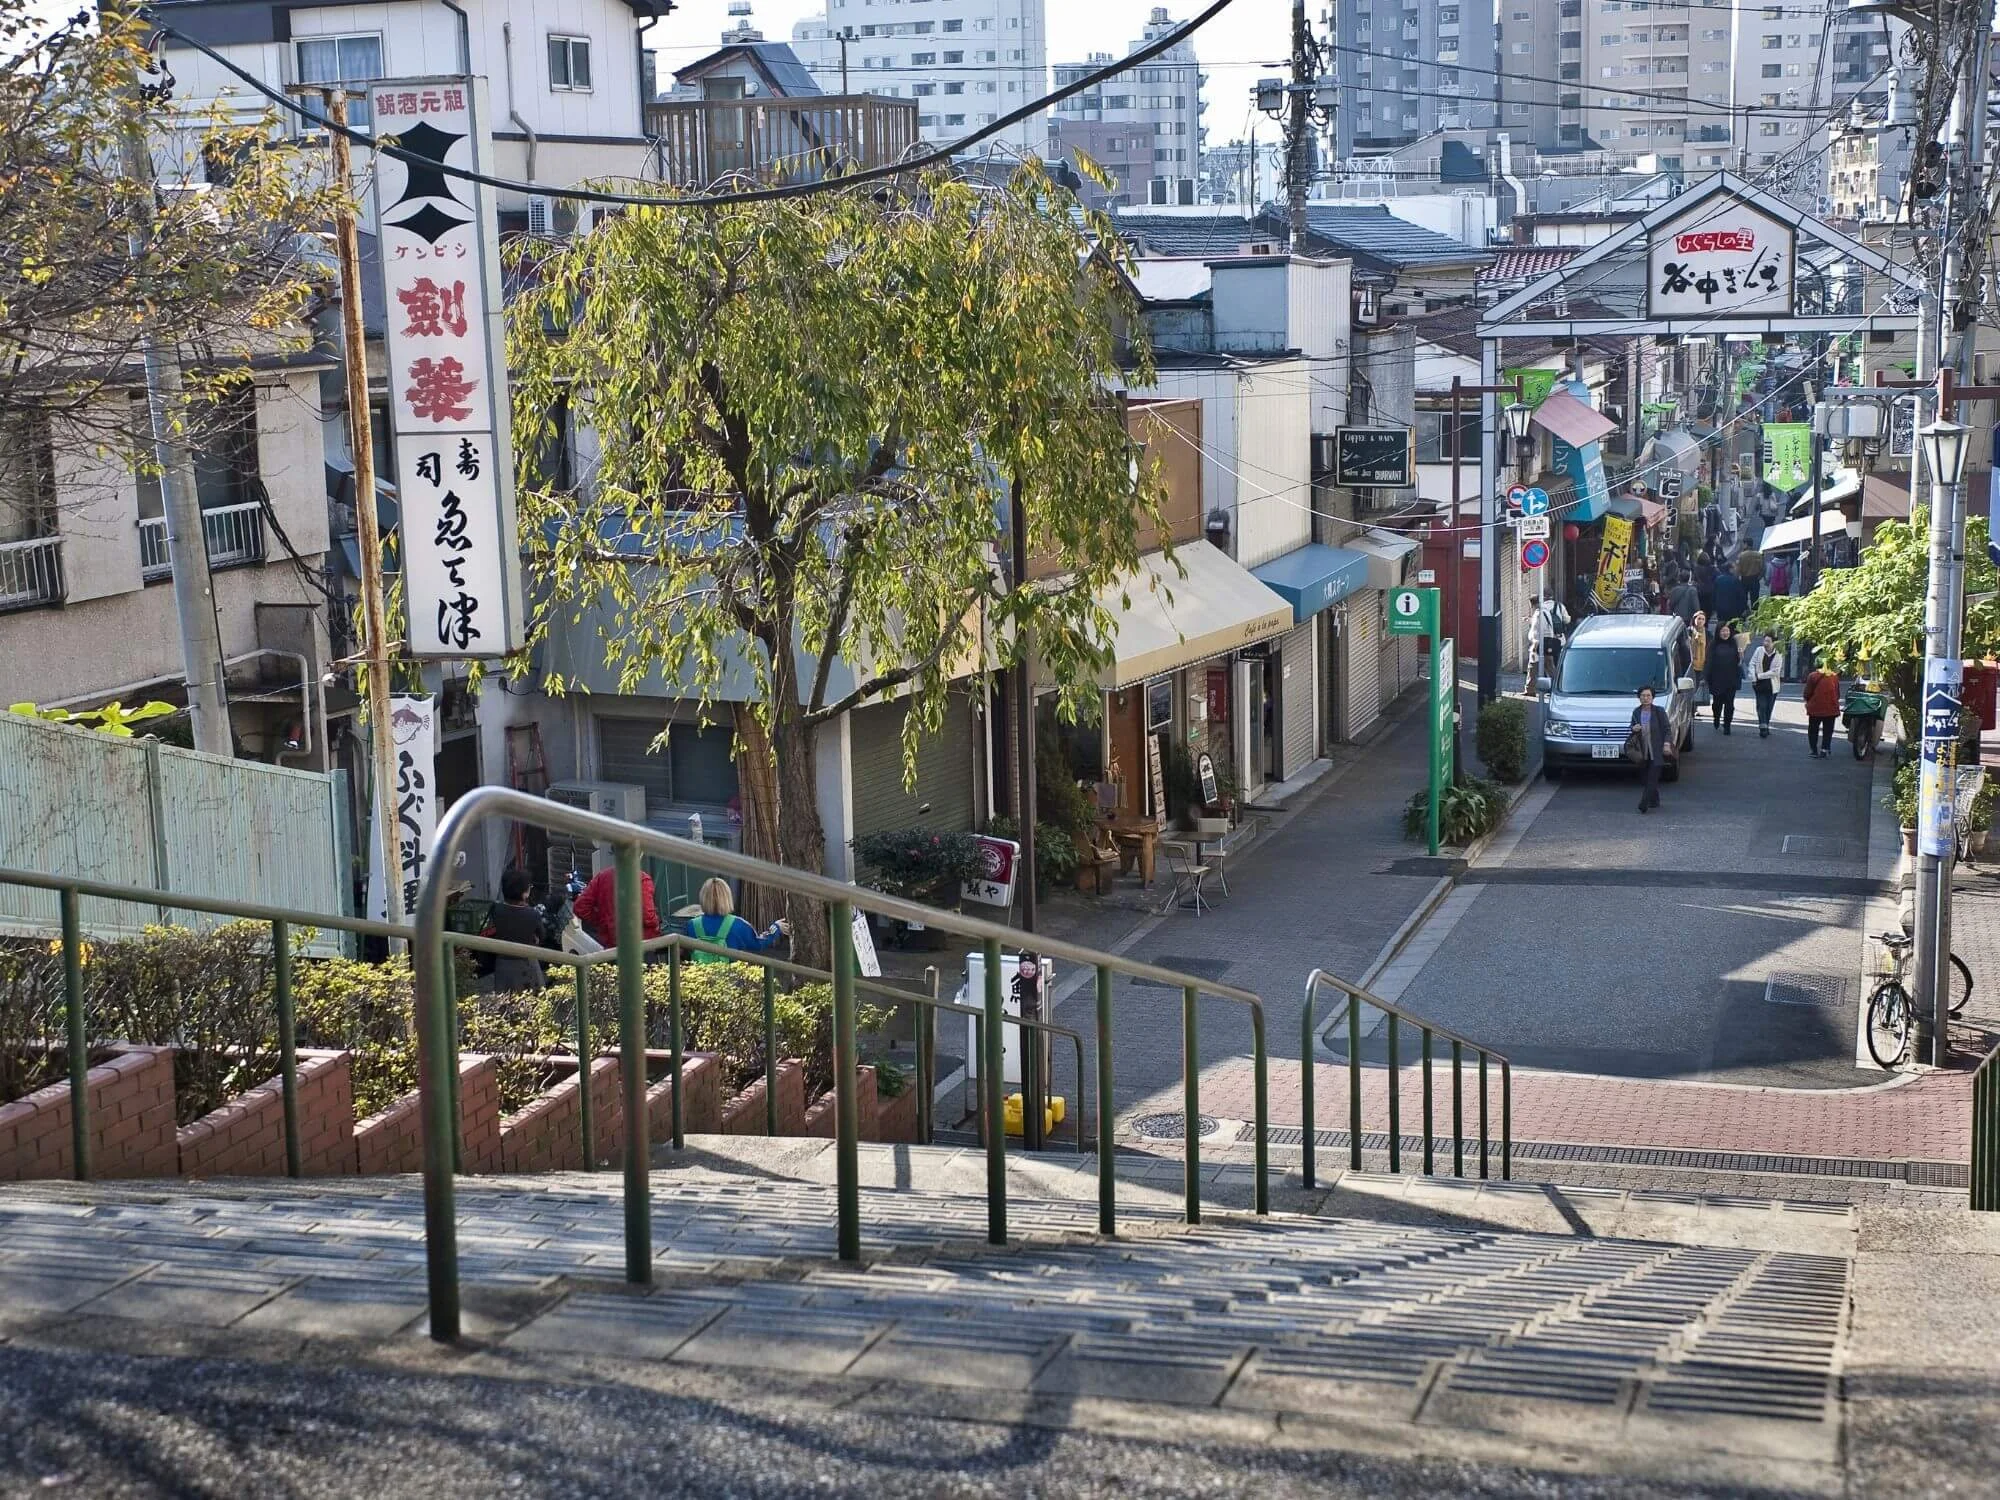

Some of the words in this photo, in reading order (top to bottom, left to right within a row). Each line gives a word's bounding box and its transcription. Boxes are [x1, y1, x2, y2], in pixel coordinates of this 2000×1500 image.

[396, 243, 467, 259] ケンビシ
[1677, 228, 1754, 252] ひぐらしの里
[1661, 246, 1781, 304] 谷中ぎんざ
